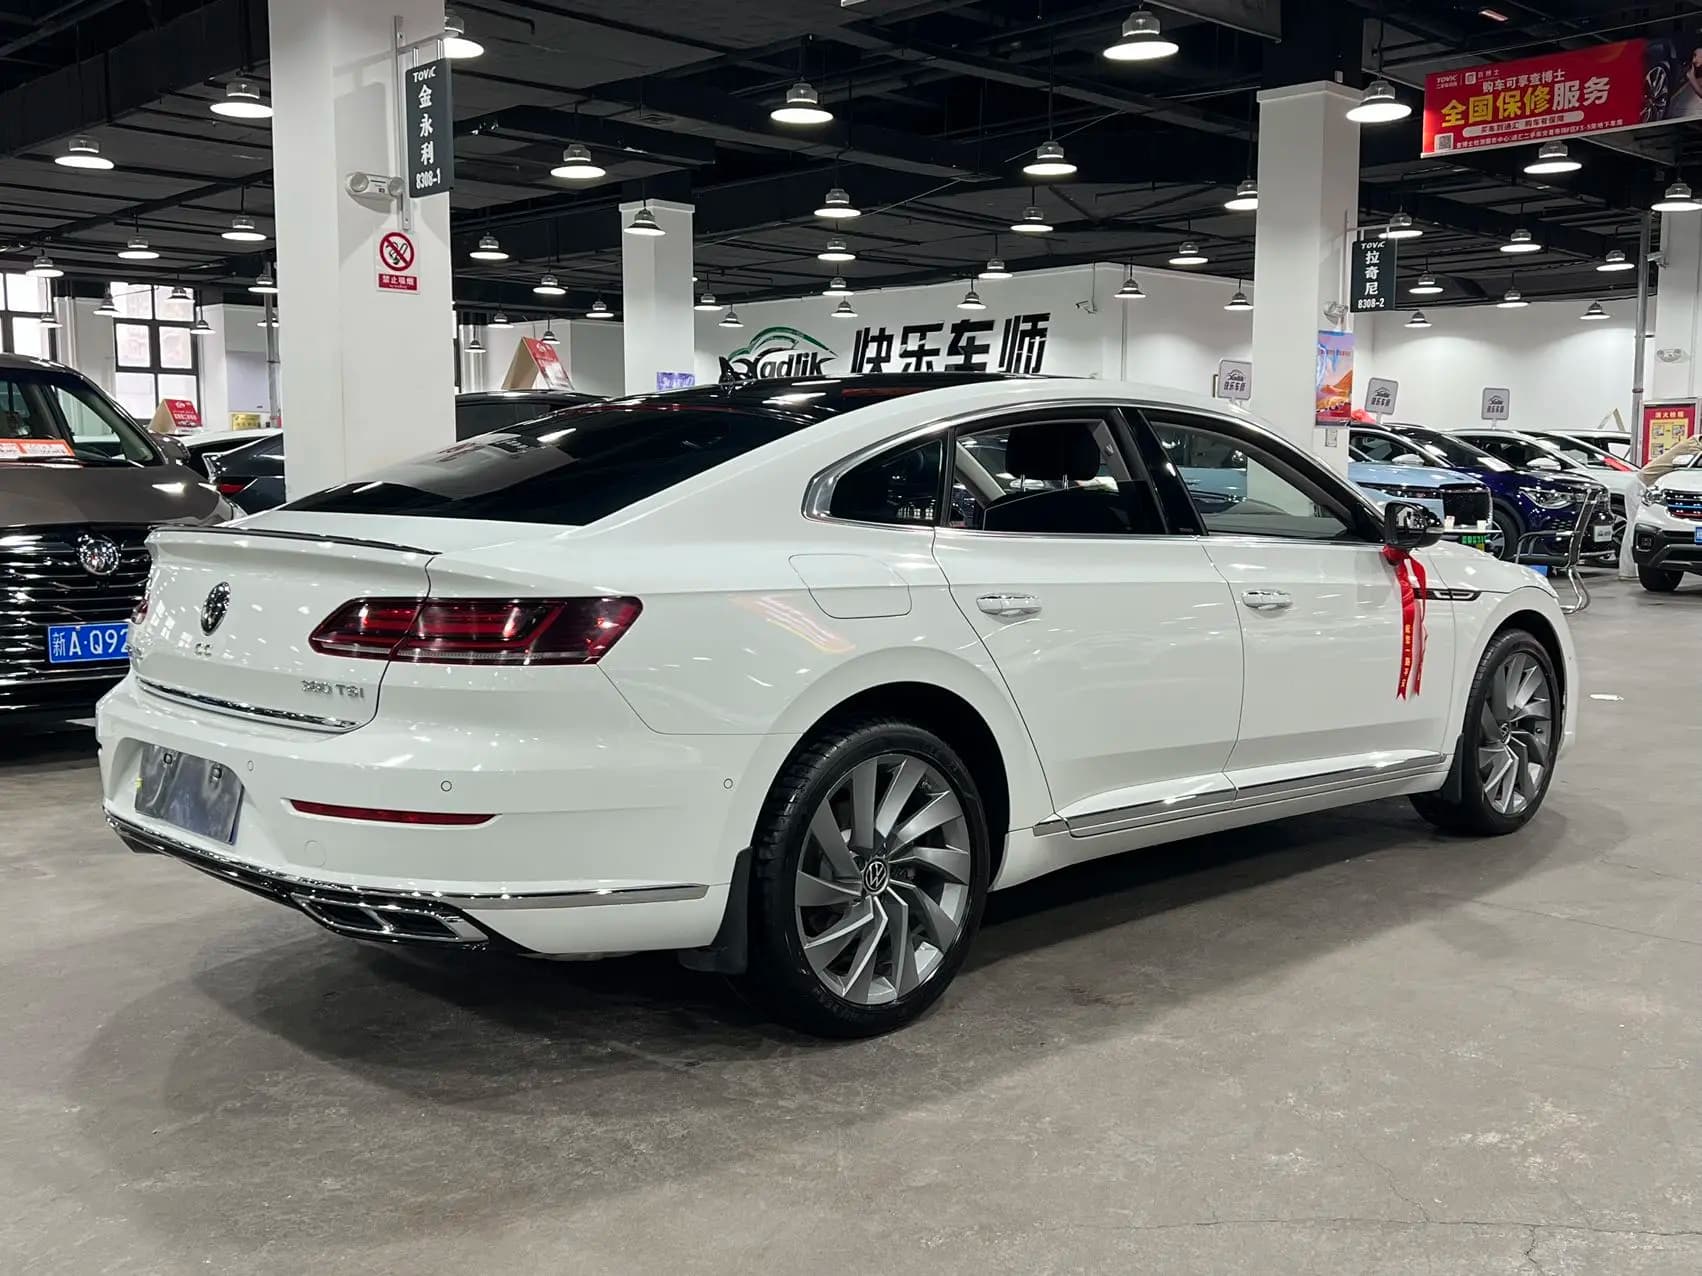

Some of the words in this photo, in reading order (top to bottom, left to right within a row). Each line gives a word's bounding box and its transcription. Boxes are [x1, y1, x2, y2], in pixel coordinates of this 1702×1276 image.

[1441, 76, 1610, 127] 全国保修服务
[1483, 69, 1565, 92] 购车可享查博士
[418, 84, 434, 166] 金永利
[416, 168, 440, 189] 8308-1
[1364, 250, 1380, 296] 拉奇尼
[852, 312, 1051, 373] 快乐车师
